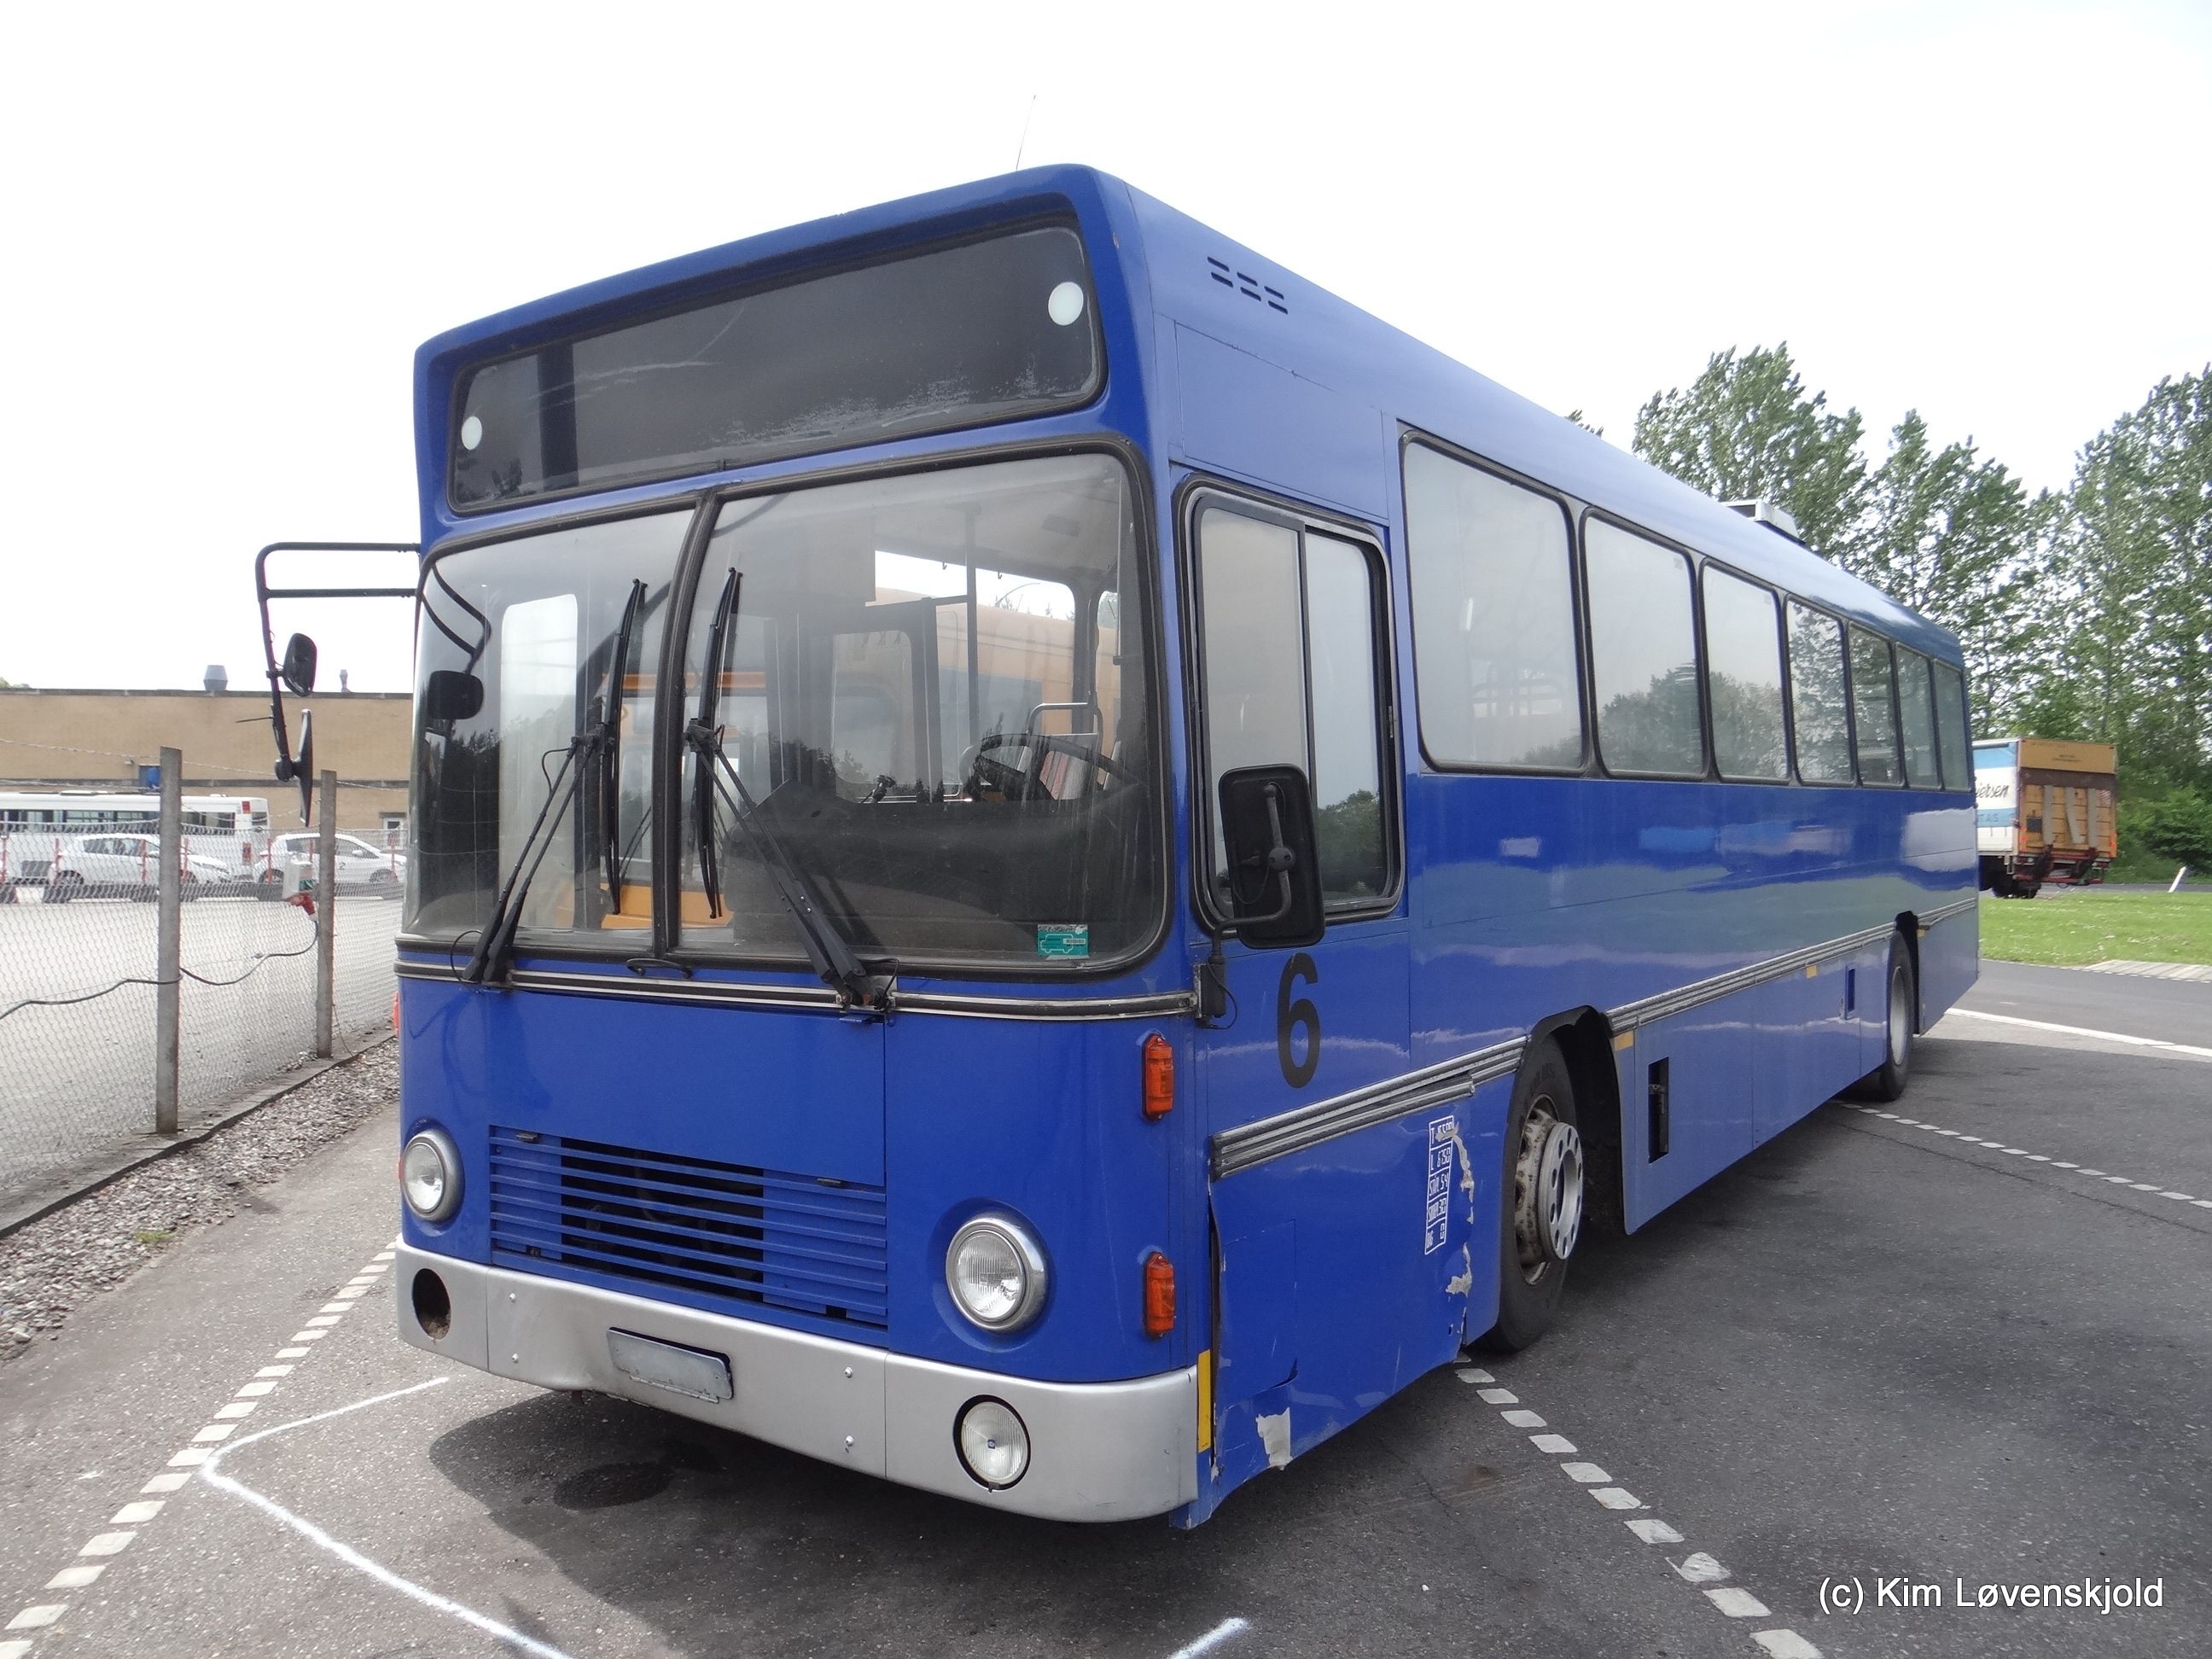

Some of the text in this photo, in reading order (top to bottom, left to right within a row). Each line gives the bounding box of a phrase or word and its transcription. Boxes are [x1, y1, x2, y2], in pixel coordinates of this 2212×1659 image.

[1277, 952, 1320, 1088] 6
[1430, 1127, 1435, 1144] T
[1430, 1154, 1435, 1171] L
[1440, 1173, 1449, 1190] 54
